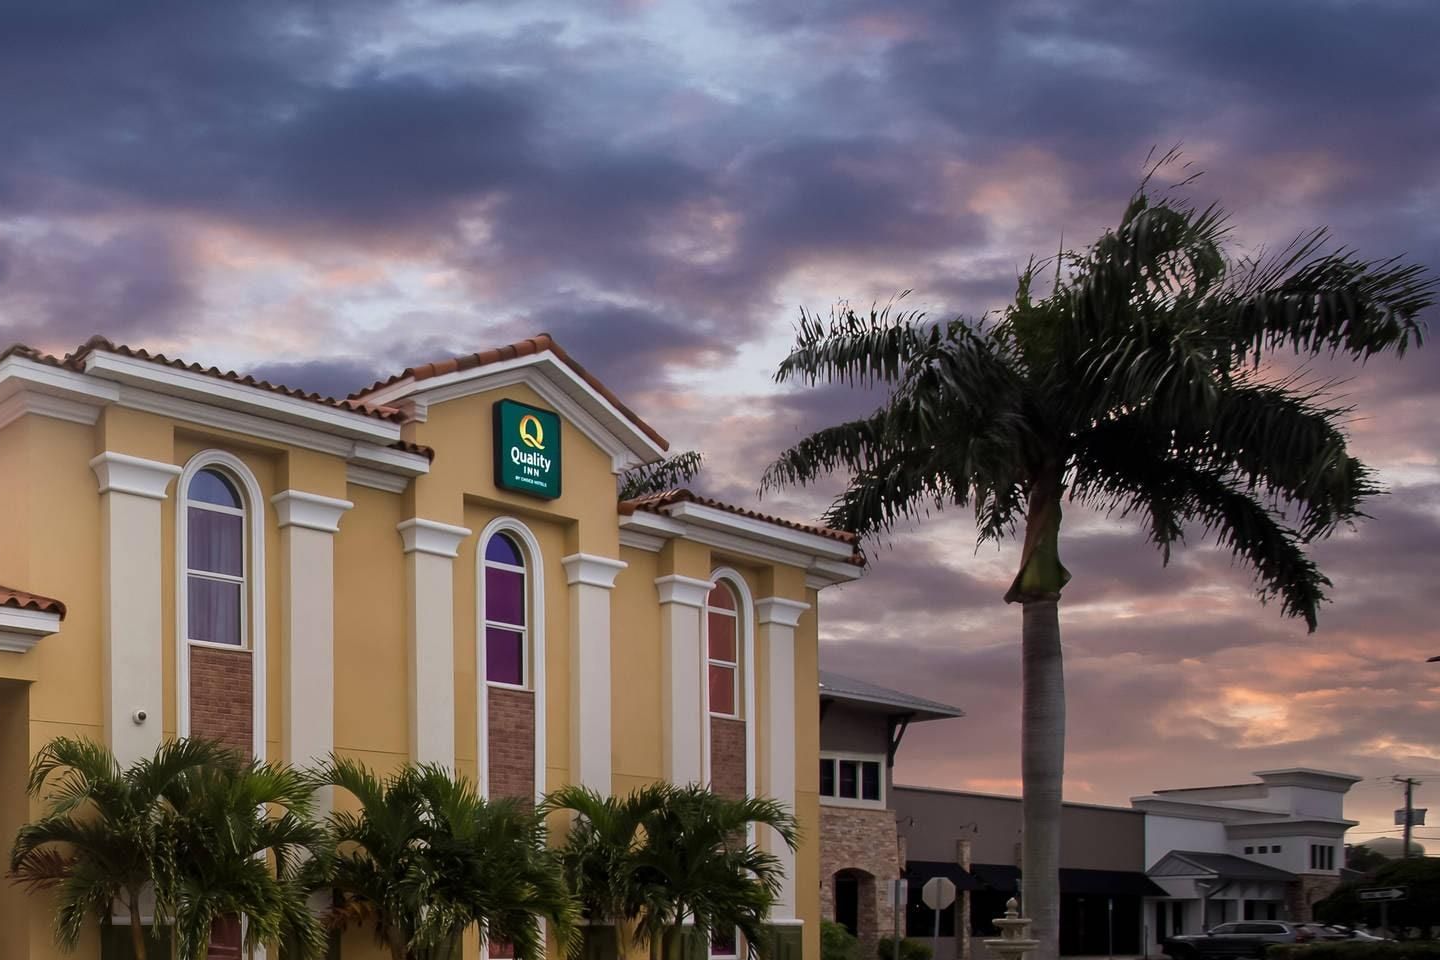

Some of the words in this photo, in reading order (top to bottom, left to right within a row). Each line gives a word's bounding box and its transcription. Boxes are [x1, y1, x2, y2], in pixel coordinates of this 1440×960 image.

[519, 415, 545, 450] Q
[511, 446, 551, 473] Quality
[523, 465, 540, 477] INN
